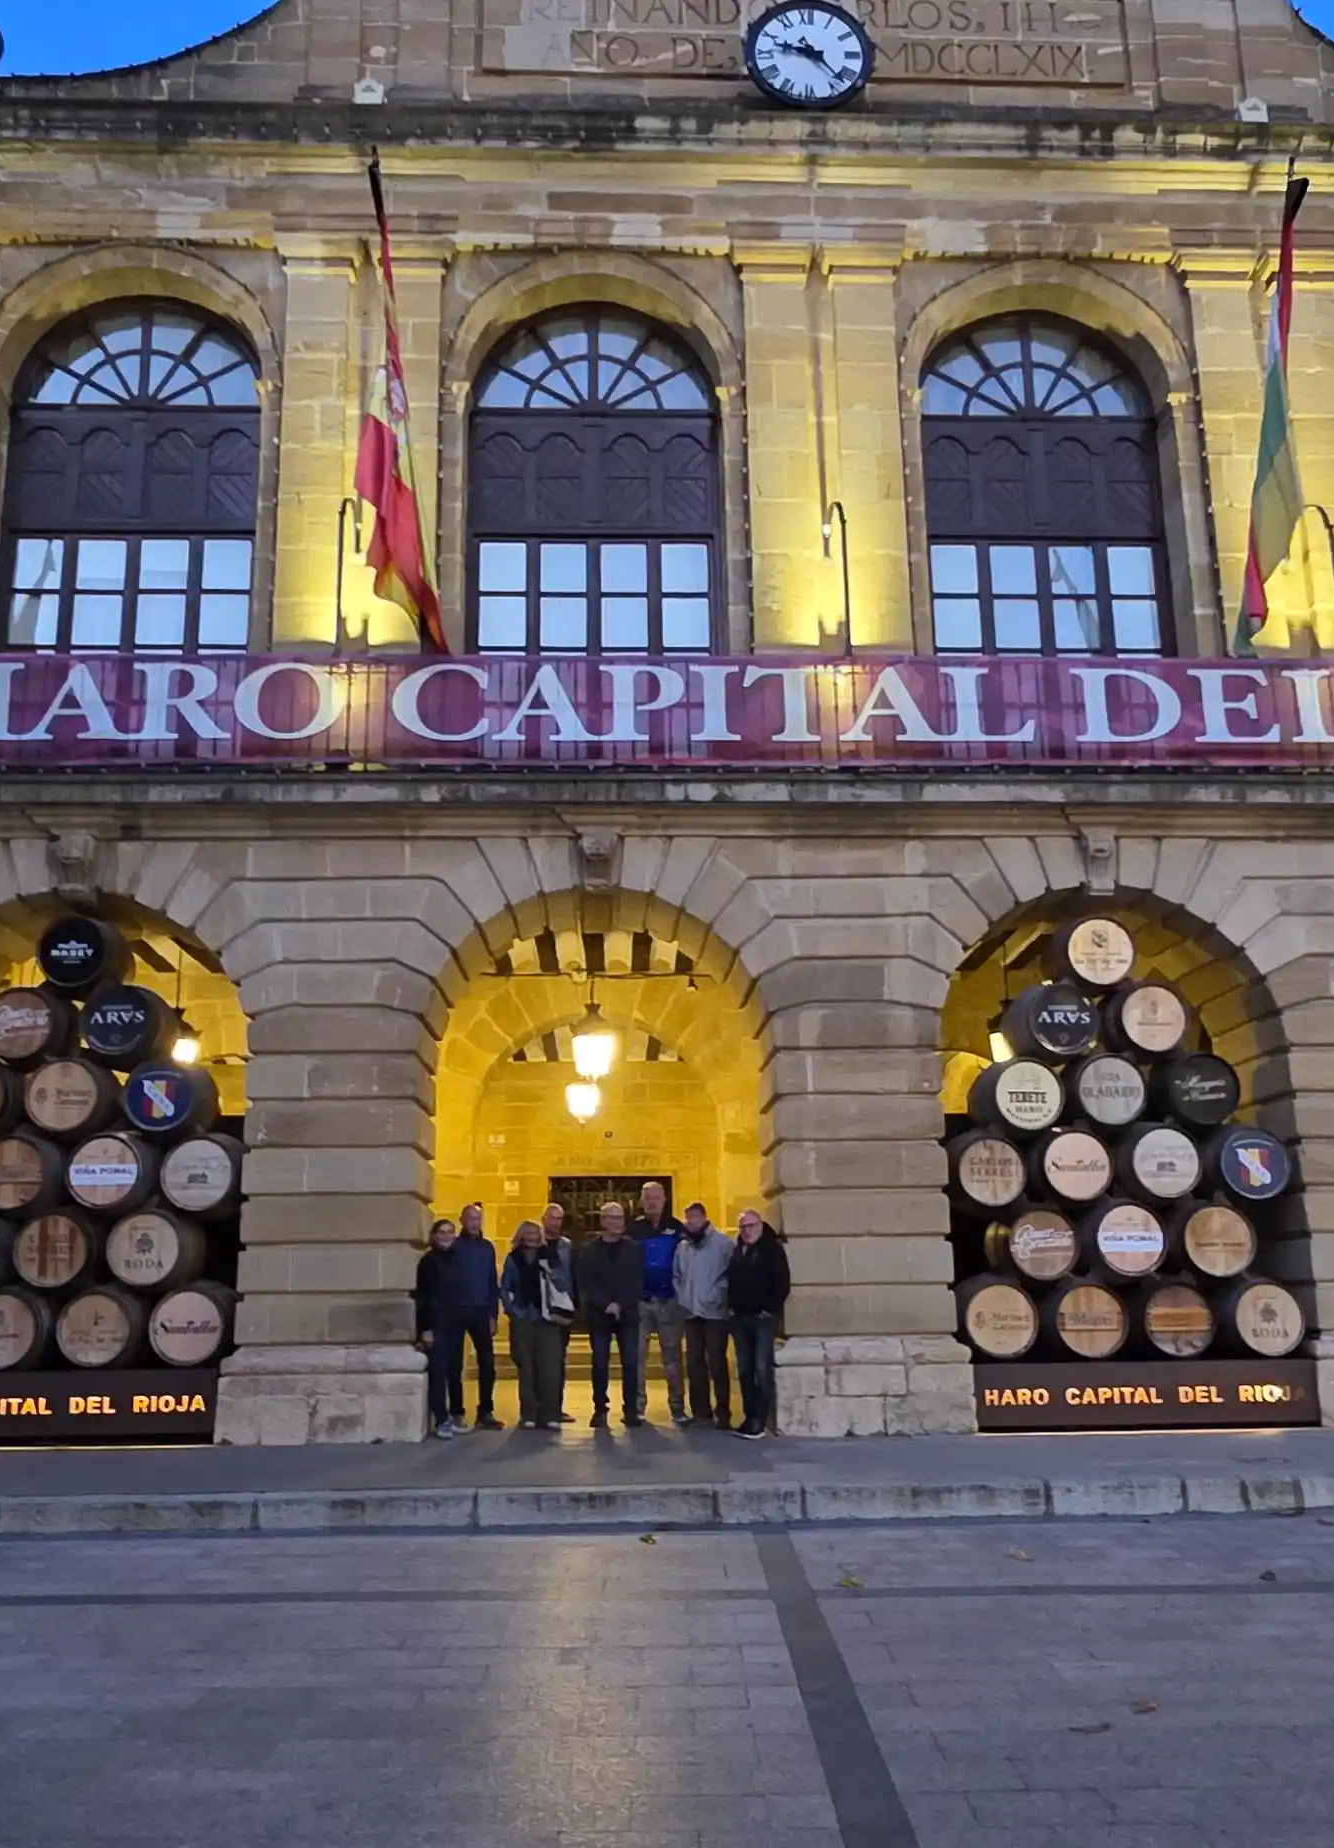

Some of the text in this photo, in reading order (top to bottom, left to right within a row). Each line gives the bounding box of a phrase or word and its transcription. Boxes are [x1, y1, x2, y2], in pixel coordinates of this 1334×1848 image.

[392, 663, 1036, 743] CAPITAL
[69, 1395, 116, 1414] DEL
[133, 1394, 206, 1414] RIOJA
[984, 1388, 1050, 1406] HARO
[1064, 1387, 1164, 1405] CAPITAL
[1177, 1385, 1224, 1404] DEL
